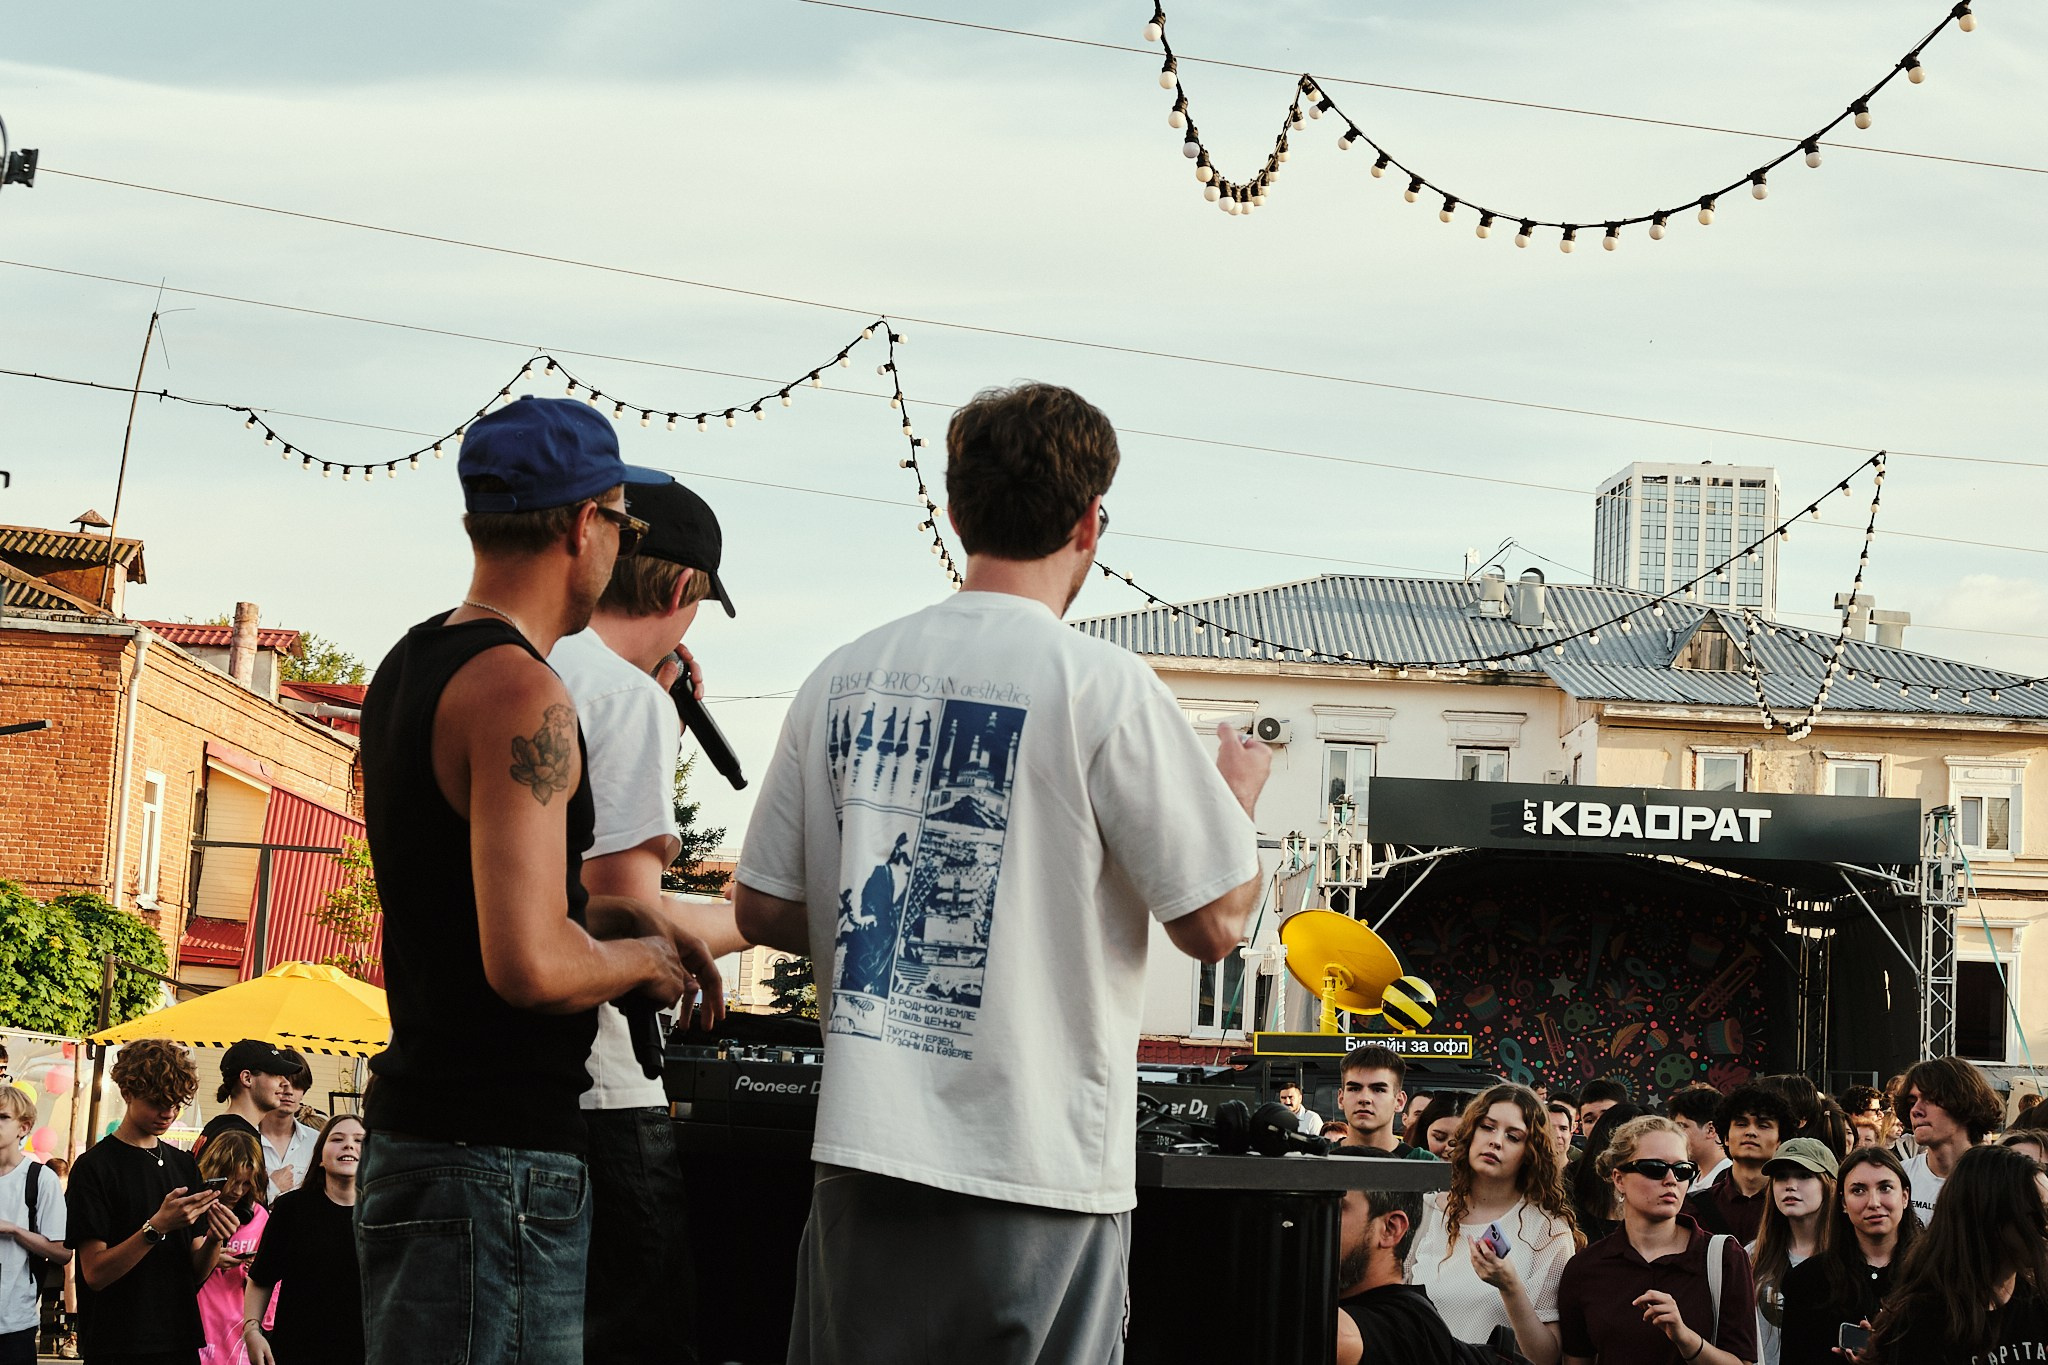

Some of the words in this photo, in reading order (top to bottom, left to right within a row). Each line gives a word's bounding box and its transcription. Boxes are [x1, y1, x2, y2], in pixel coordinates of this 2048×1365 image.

[1523, 799, 1538, 834] АРТ
[888, 1008, 896, 1016] И
[899, 1010, 921, 1023] ПЫЛЬ
[890, 997, 896, 1005] В
[945, 1007, 976, 1021] ЗЕМЛЕ
[1410, 1040, 1428, 1052] за
[1433, 1038, 1468, 1056] офл
[735, 1075, 806, 1094] Pioneer
[810, 1080, 821, 1095] D
